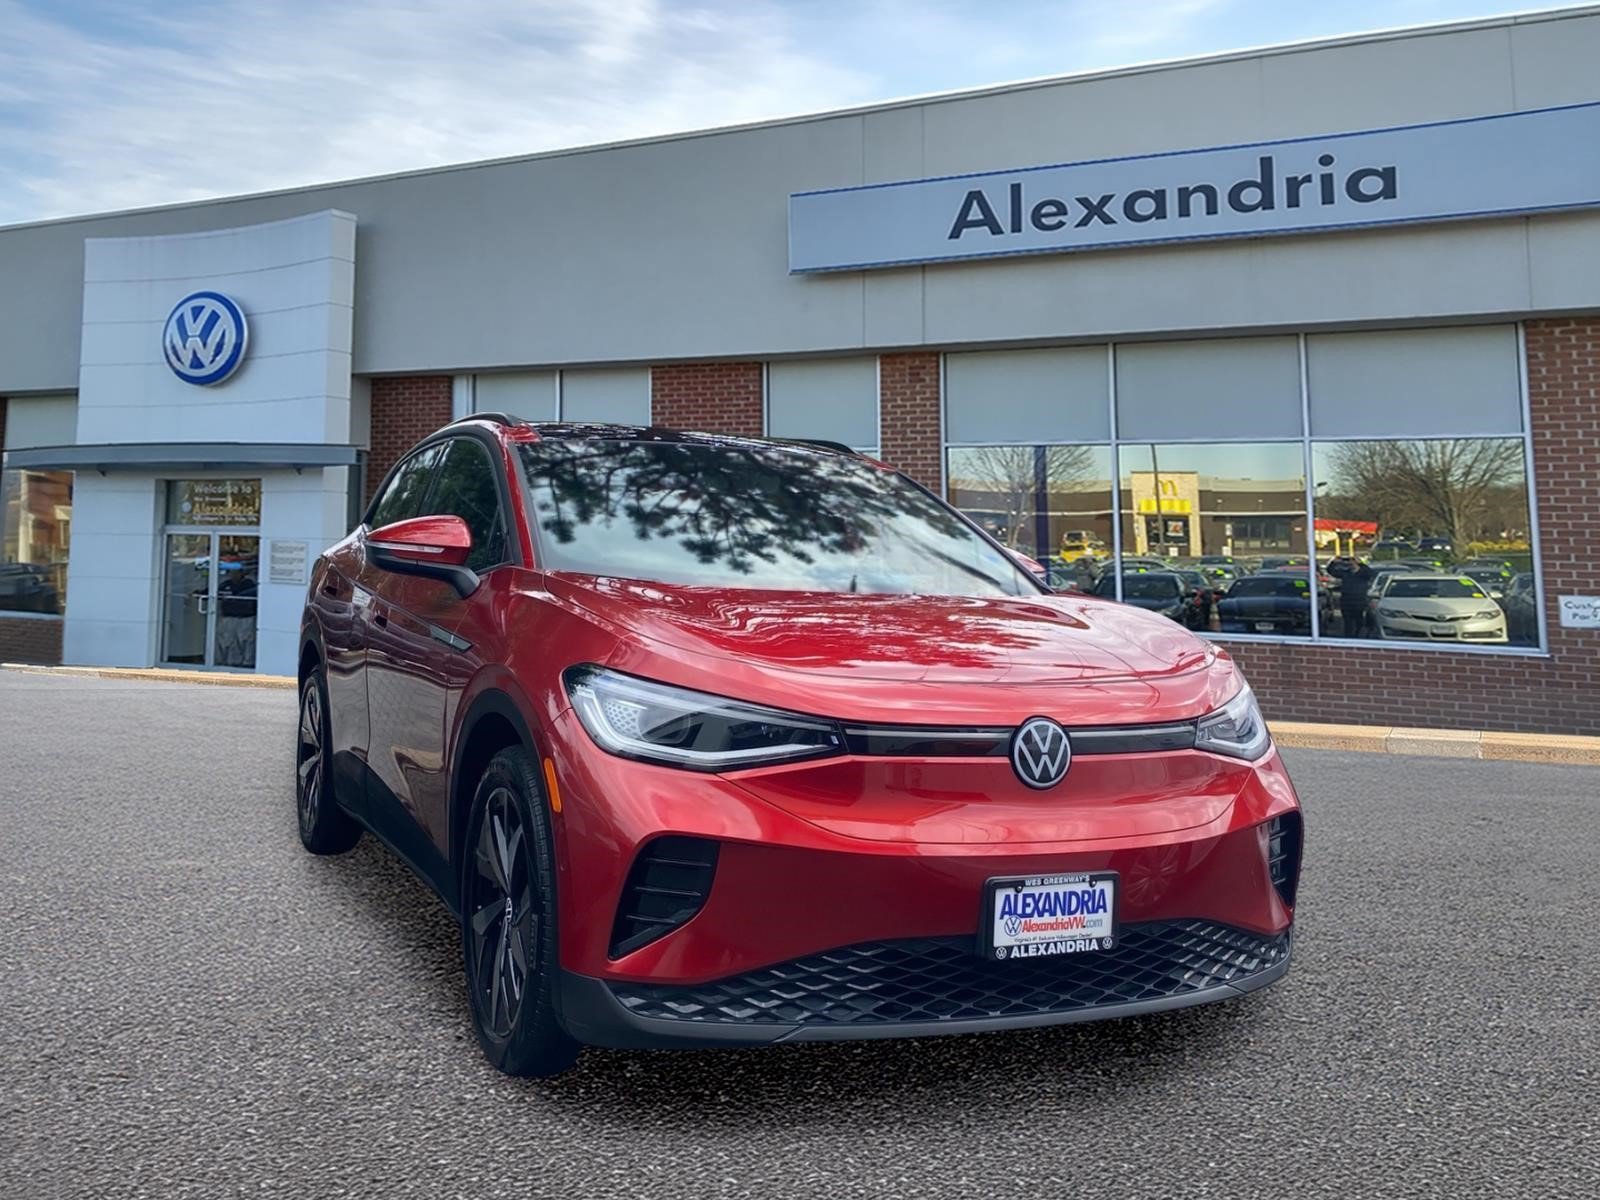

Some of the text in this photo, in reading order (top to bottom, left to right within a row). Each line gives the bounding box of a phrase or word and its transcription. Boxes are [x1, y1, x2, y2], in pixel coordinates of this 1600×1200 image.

[947, 154, 1399, 242] Alexandria
[1013, 719, 1071, 787] VW
[1043, 875, 1090, 885] GREENWAY'S
[1000, 889, 1107, 920] ALEXANDRIA
[1021, 917, 1103, 933] AlexandriaVW.com
[1010, 938, 1099, 958] ALEXANDRIA
